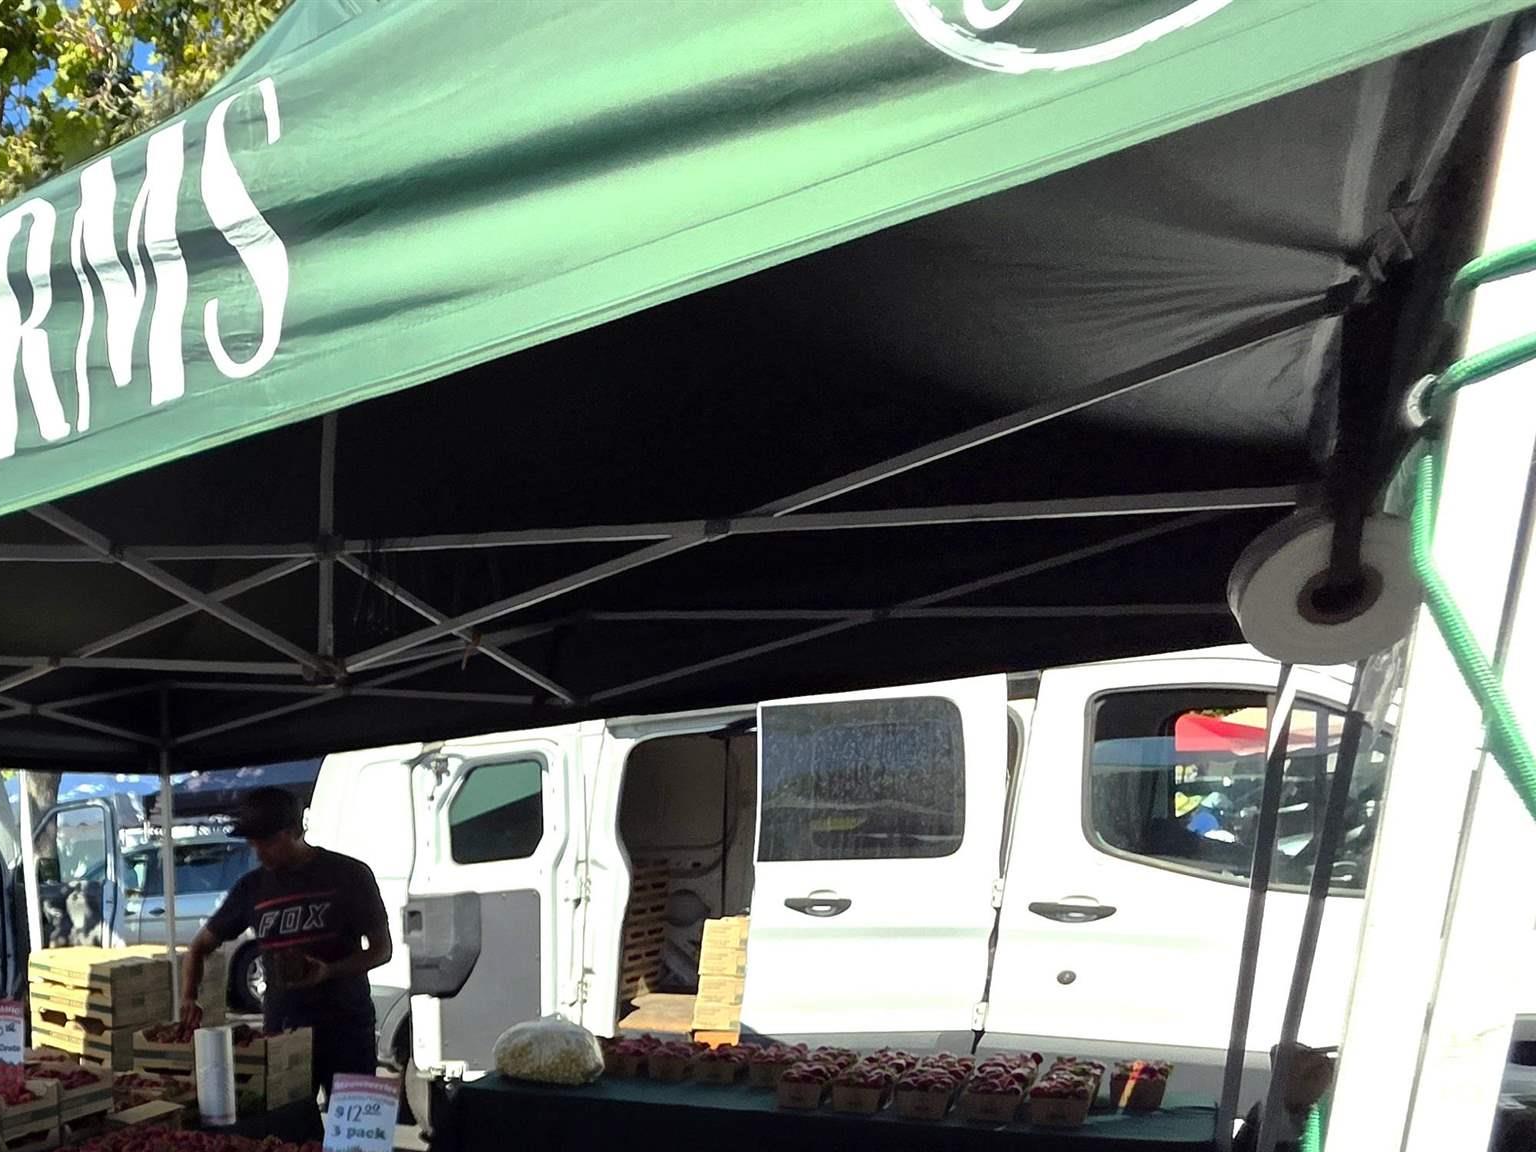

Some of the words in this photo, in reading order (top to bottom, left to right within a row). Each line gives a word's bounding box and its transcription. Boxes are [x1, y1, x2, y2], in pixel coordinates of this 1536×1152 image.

[258, 902, 331, 938] FOX
[331, 1125, 341, 1137] 3
[346, 1126, 386, 1141] pack
